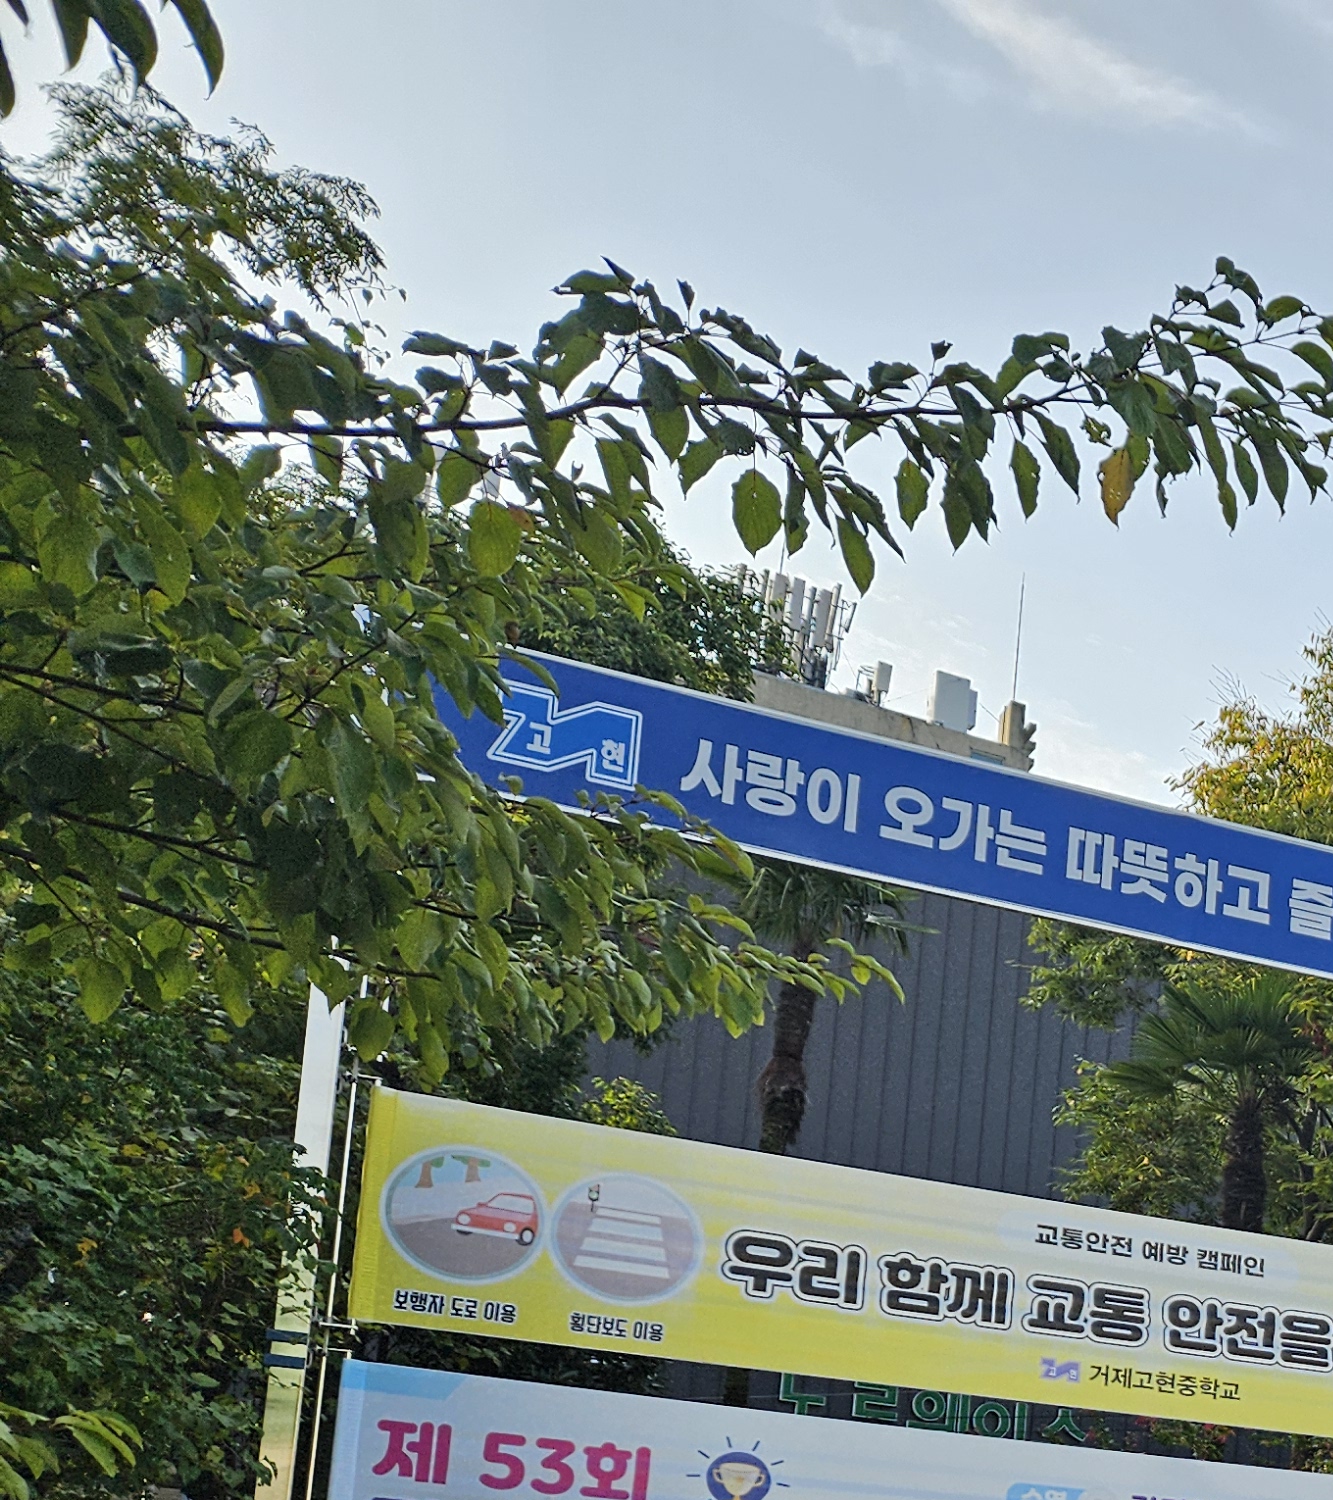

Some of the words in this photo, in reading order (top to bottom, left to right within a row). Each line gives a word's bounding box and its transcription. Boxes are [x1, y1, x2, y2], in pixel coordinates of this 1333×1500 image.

[527, 723, 551, 754] 고
[601, 740, 624, 772] 현
[680, 739, 861, 832] 사랑이
[880, 786, 1047, 875] 오가는
[1067, 827, 1271, 926] 따뜻하고
[1034, 1224, 1133, 1259] 교통안전
[1141, 1243, 1189, 1267] 예방
[1197, 1250, 1265, 1279] 캠페인
[394, 1290, 445, 1317] 보행자
[451, 1295, 480, 1320] 도로
[483, 1300, 517, 1324] 이용
[723, 1233, 861, 1306] 우리
[882, 1256, 1009, 1325] 함께
[1024, 1277, 1149, 1345] 교통
[569, 1311, 628, 1339] 횡단보도
[633, 1319, 664, 1343] 이용
[1088, 1363, 1242, 1401] 거제고현중학교
[372, 1419, 452, 1485] 제
